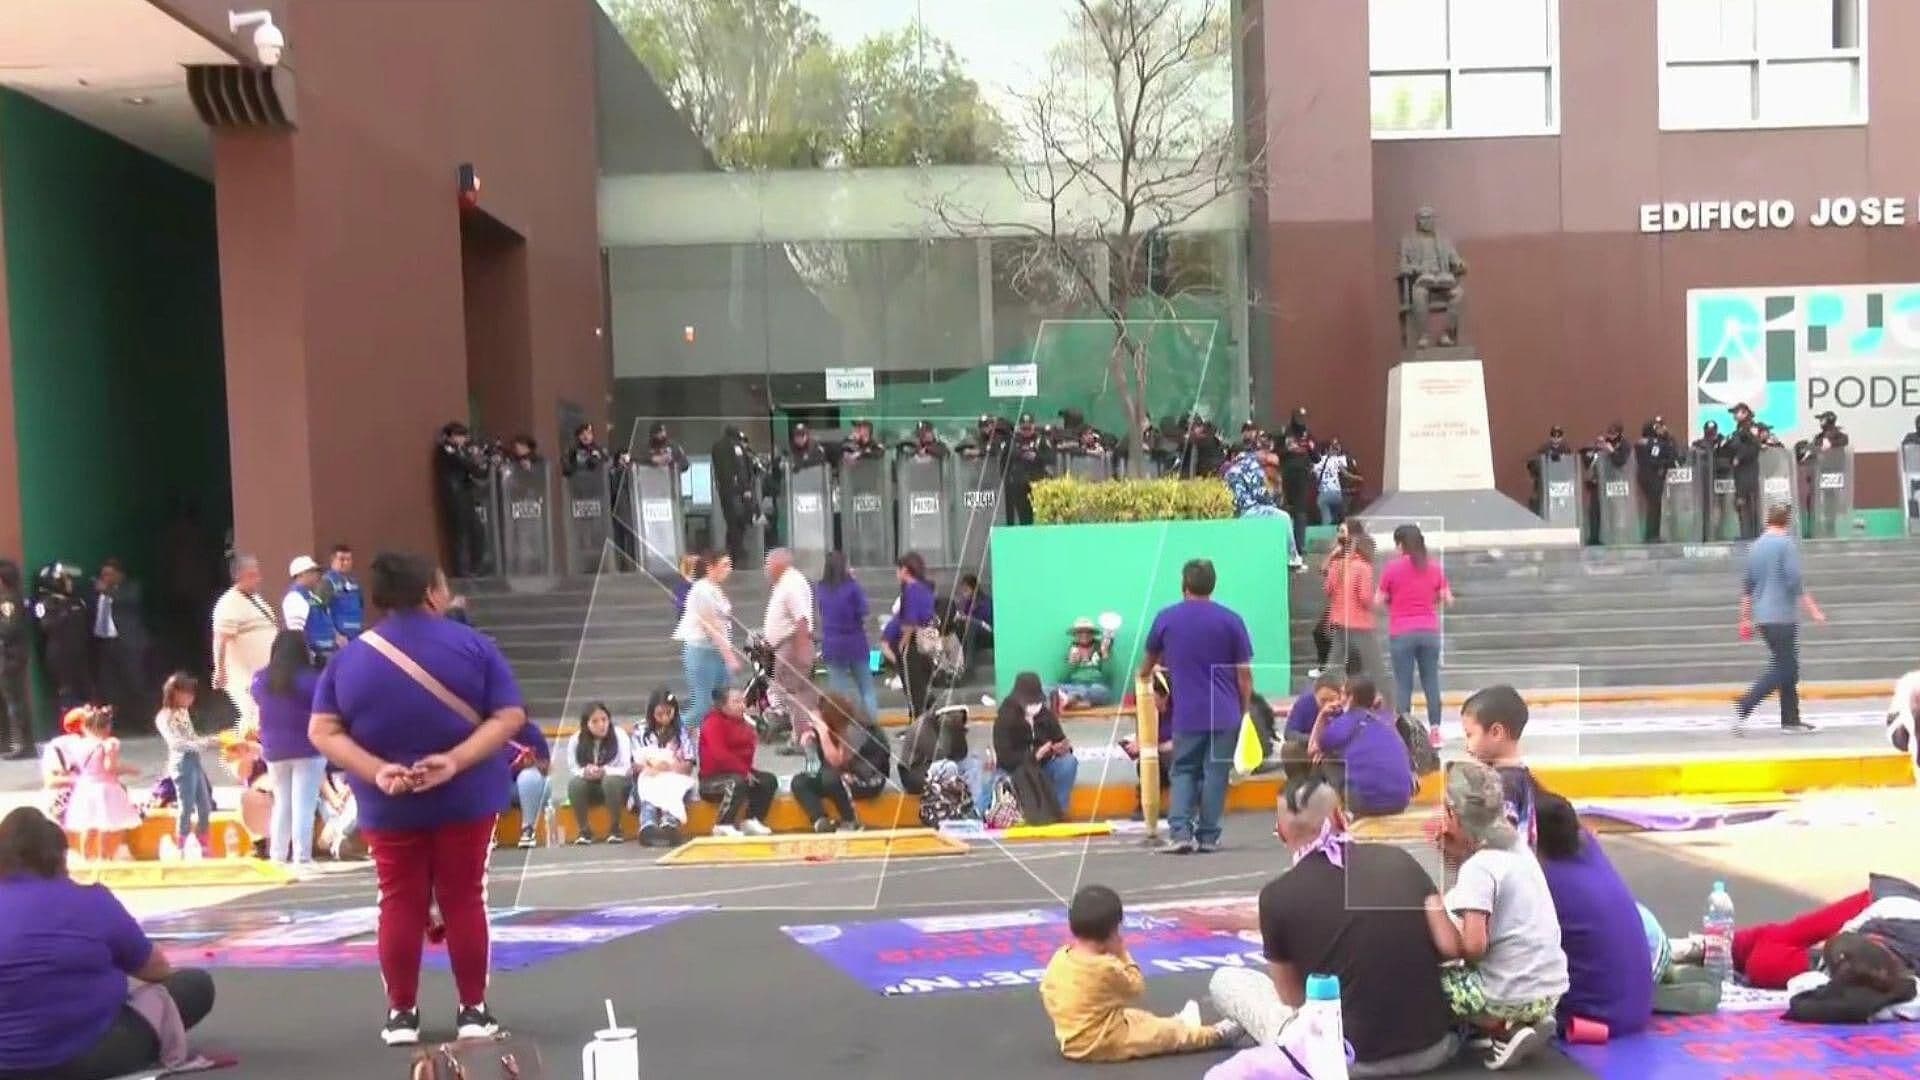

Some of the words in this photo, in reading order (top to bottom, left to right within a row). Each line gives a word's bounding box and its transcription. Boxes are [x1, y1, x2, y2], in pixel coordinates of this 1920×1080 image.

[1640, 200, 1795, 232] EDIFICIO
[1810, 197, 1905, 227] JOSE
[837, 378, 865, 389] Salida
[1808, 374, 1920, 410] PODE
